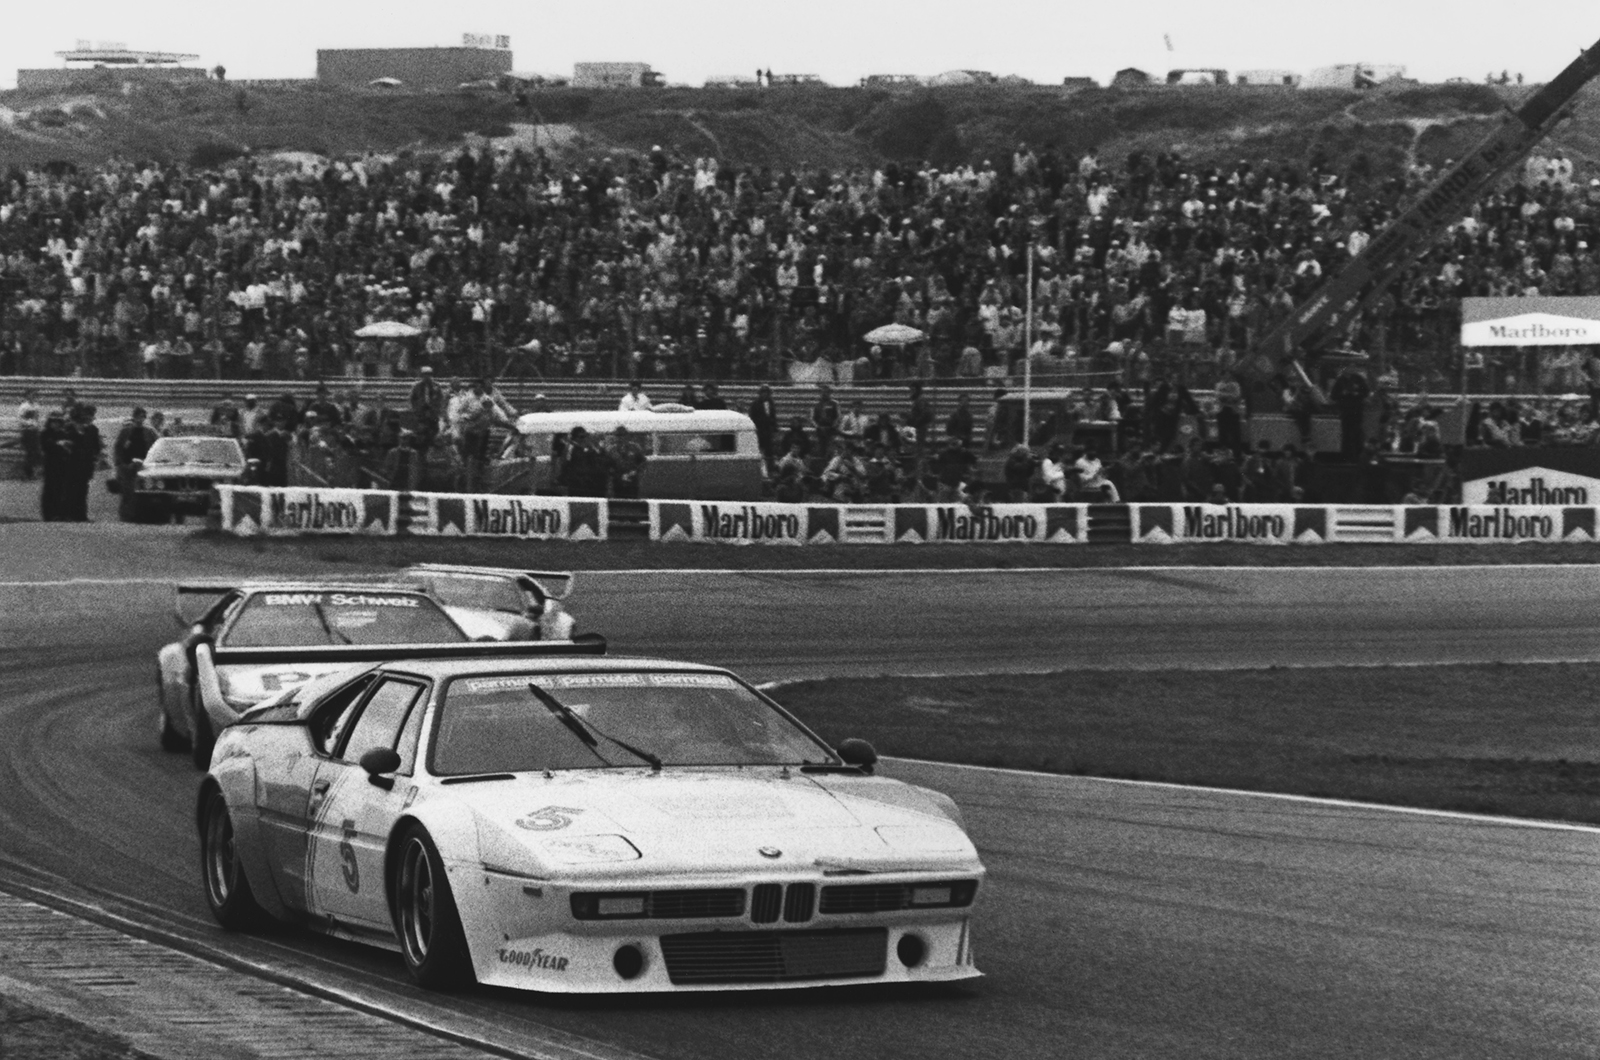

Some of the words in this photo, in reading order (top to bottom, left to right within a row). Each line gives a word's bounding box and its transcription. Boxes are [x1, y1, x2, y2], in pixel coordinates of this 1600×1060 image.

[1418, 161, 1480, 219] HARDE
[1489, 324, 1587, 338] Marlboro
[270, 491, 358, 528] Marlboro
[473, 498, 562, 532] Marlboro
[700, 503, 799, 539] Marlboro
[936, 506, 1038, 539] Marlboro
[1182, 505, 1286, 538] Marlboro
[1449, 507, 1553, 539] Marlboro
[514, 805, 586, 832] 5
[340, 819, 360, 894] 5
[496, 948, 569, 971] GOODYEAR
